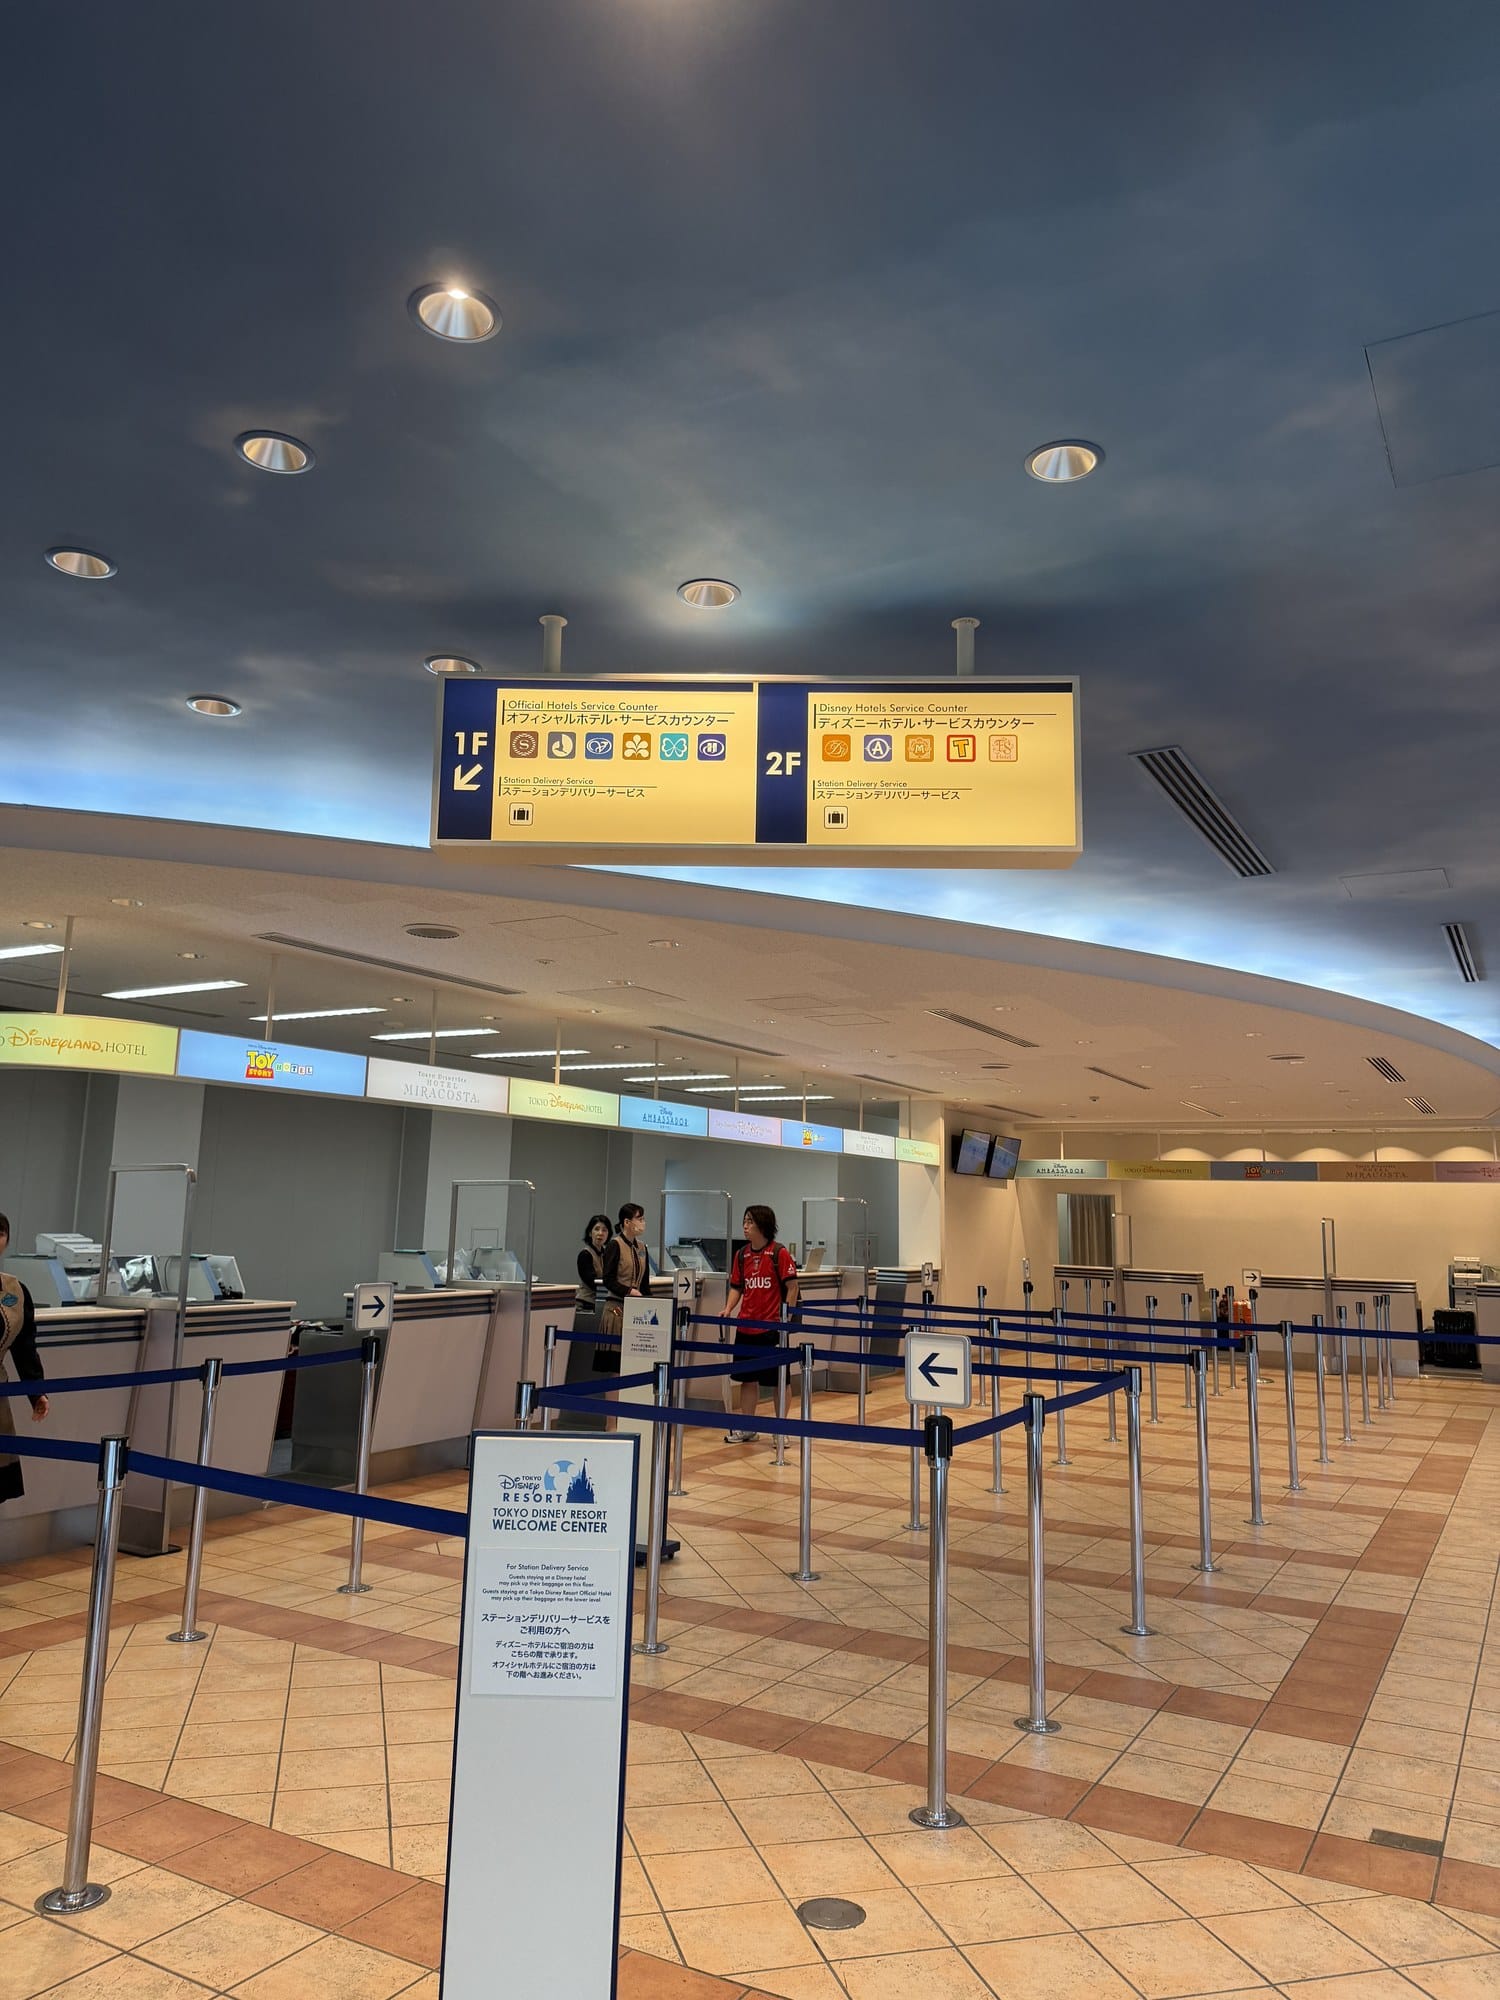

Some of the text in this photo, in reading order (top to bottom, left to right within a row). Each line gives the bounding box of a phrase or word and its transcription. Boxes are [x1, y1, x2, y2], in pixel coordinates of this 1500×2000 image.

[508, 700, 658, 711] Official Hotels Service Counter
[819, 703, 968, 715] Disney Hotels Service Counter
[506, 712, 729, 727] オフィシャルホテル・サービスカウンター
[818, 717, 1034, 729] ディズニーホテル・サービスカウンター
[454, 731, 488, 755] 1F
[765, 751, 801, 776] 2F
[503, 776, 593, 786] Station Delivery Service
[846, 780, 877, 789] Delivery
[502, 787, 645, 798] ステーションデリバリーサービス
[816, 790, 960, 800] ステーションデリバリーサービス
[105, 1041, 147, 1056] HOTEL
[247, 1050, 278, 1069] TOY
[248, 1068, 273, 1077] STORY
[276, 1063, 313, 1075] HOTEL
[403, 1083, 478, 1104] MIRACOSTA
[528, 1096, 549, 1107] TOKYO
[585, 1105, 603, 1114] HOTEL
[642, 1113, 689, 1127] AMBASSADOR
[1245, 1166, 1262, 1174] TOY
[745, 1277, 772, 1289] POLUS
[503, 1492, 562, 1503] RESORT
[493, 1507, 607, 1520] TOKYO DISNEY RESORT
[492, 1519, 607, 1533] WELCOME CENTER
[541, 1564, 566, 1572] Delivery
[481, 1613, 611, 1624] ステーションデリバリーサービスを
[520, 1625, 571, 1635] ご利用の方へ
[495, 1640, 594, 1650] ディズニーホテルにご宿泊の方は
[511, 1650, 578, 1659] こちらの階で承ります。
[492, 1661, 596, 1670] オフィシャルホテルにご宿泊の方は
[506, 1670, 582, 1680] 下の階へお進みください。
